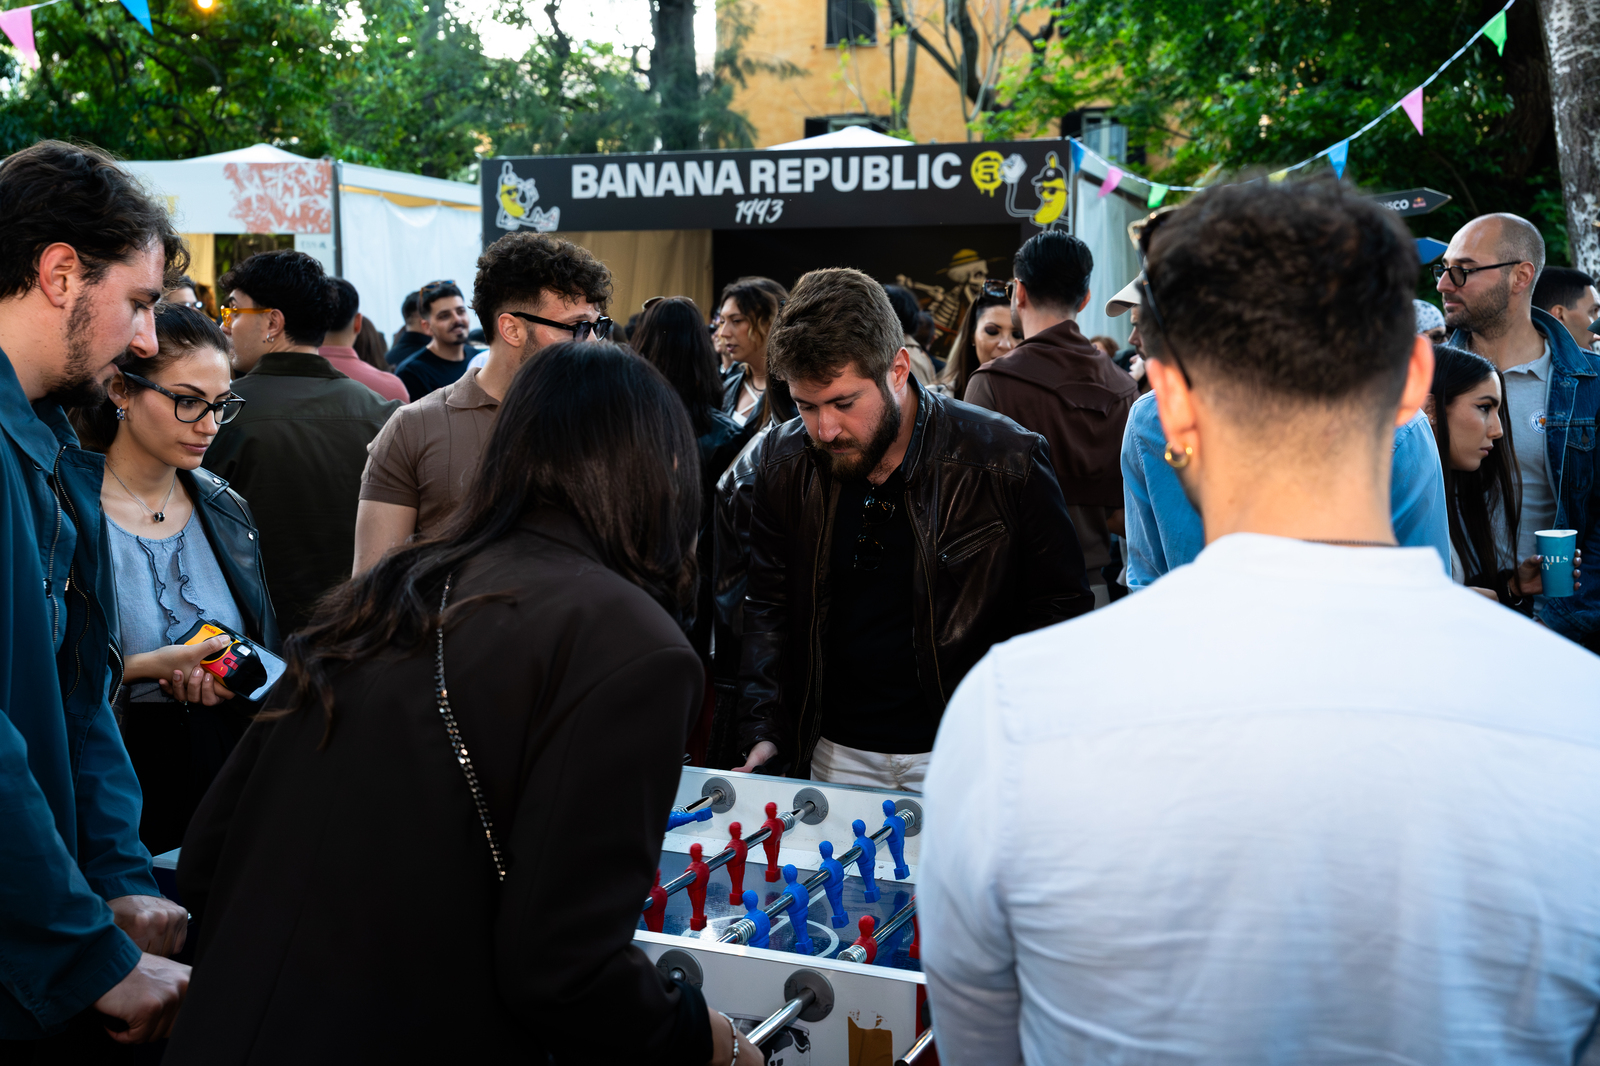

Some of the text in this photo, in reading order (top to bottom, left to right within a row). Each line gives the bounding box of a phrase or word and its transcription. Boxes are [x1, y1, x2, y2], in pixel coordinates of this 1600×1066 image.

[571, 152, 962, 199] BANANA REPUBLIC
[735, 198, 784, 225] 1993
